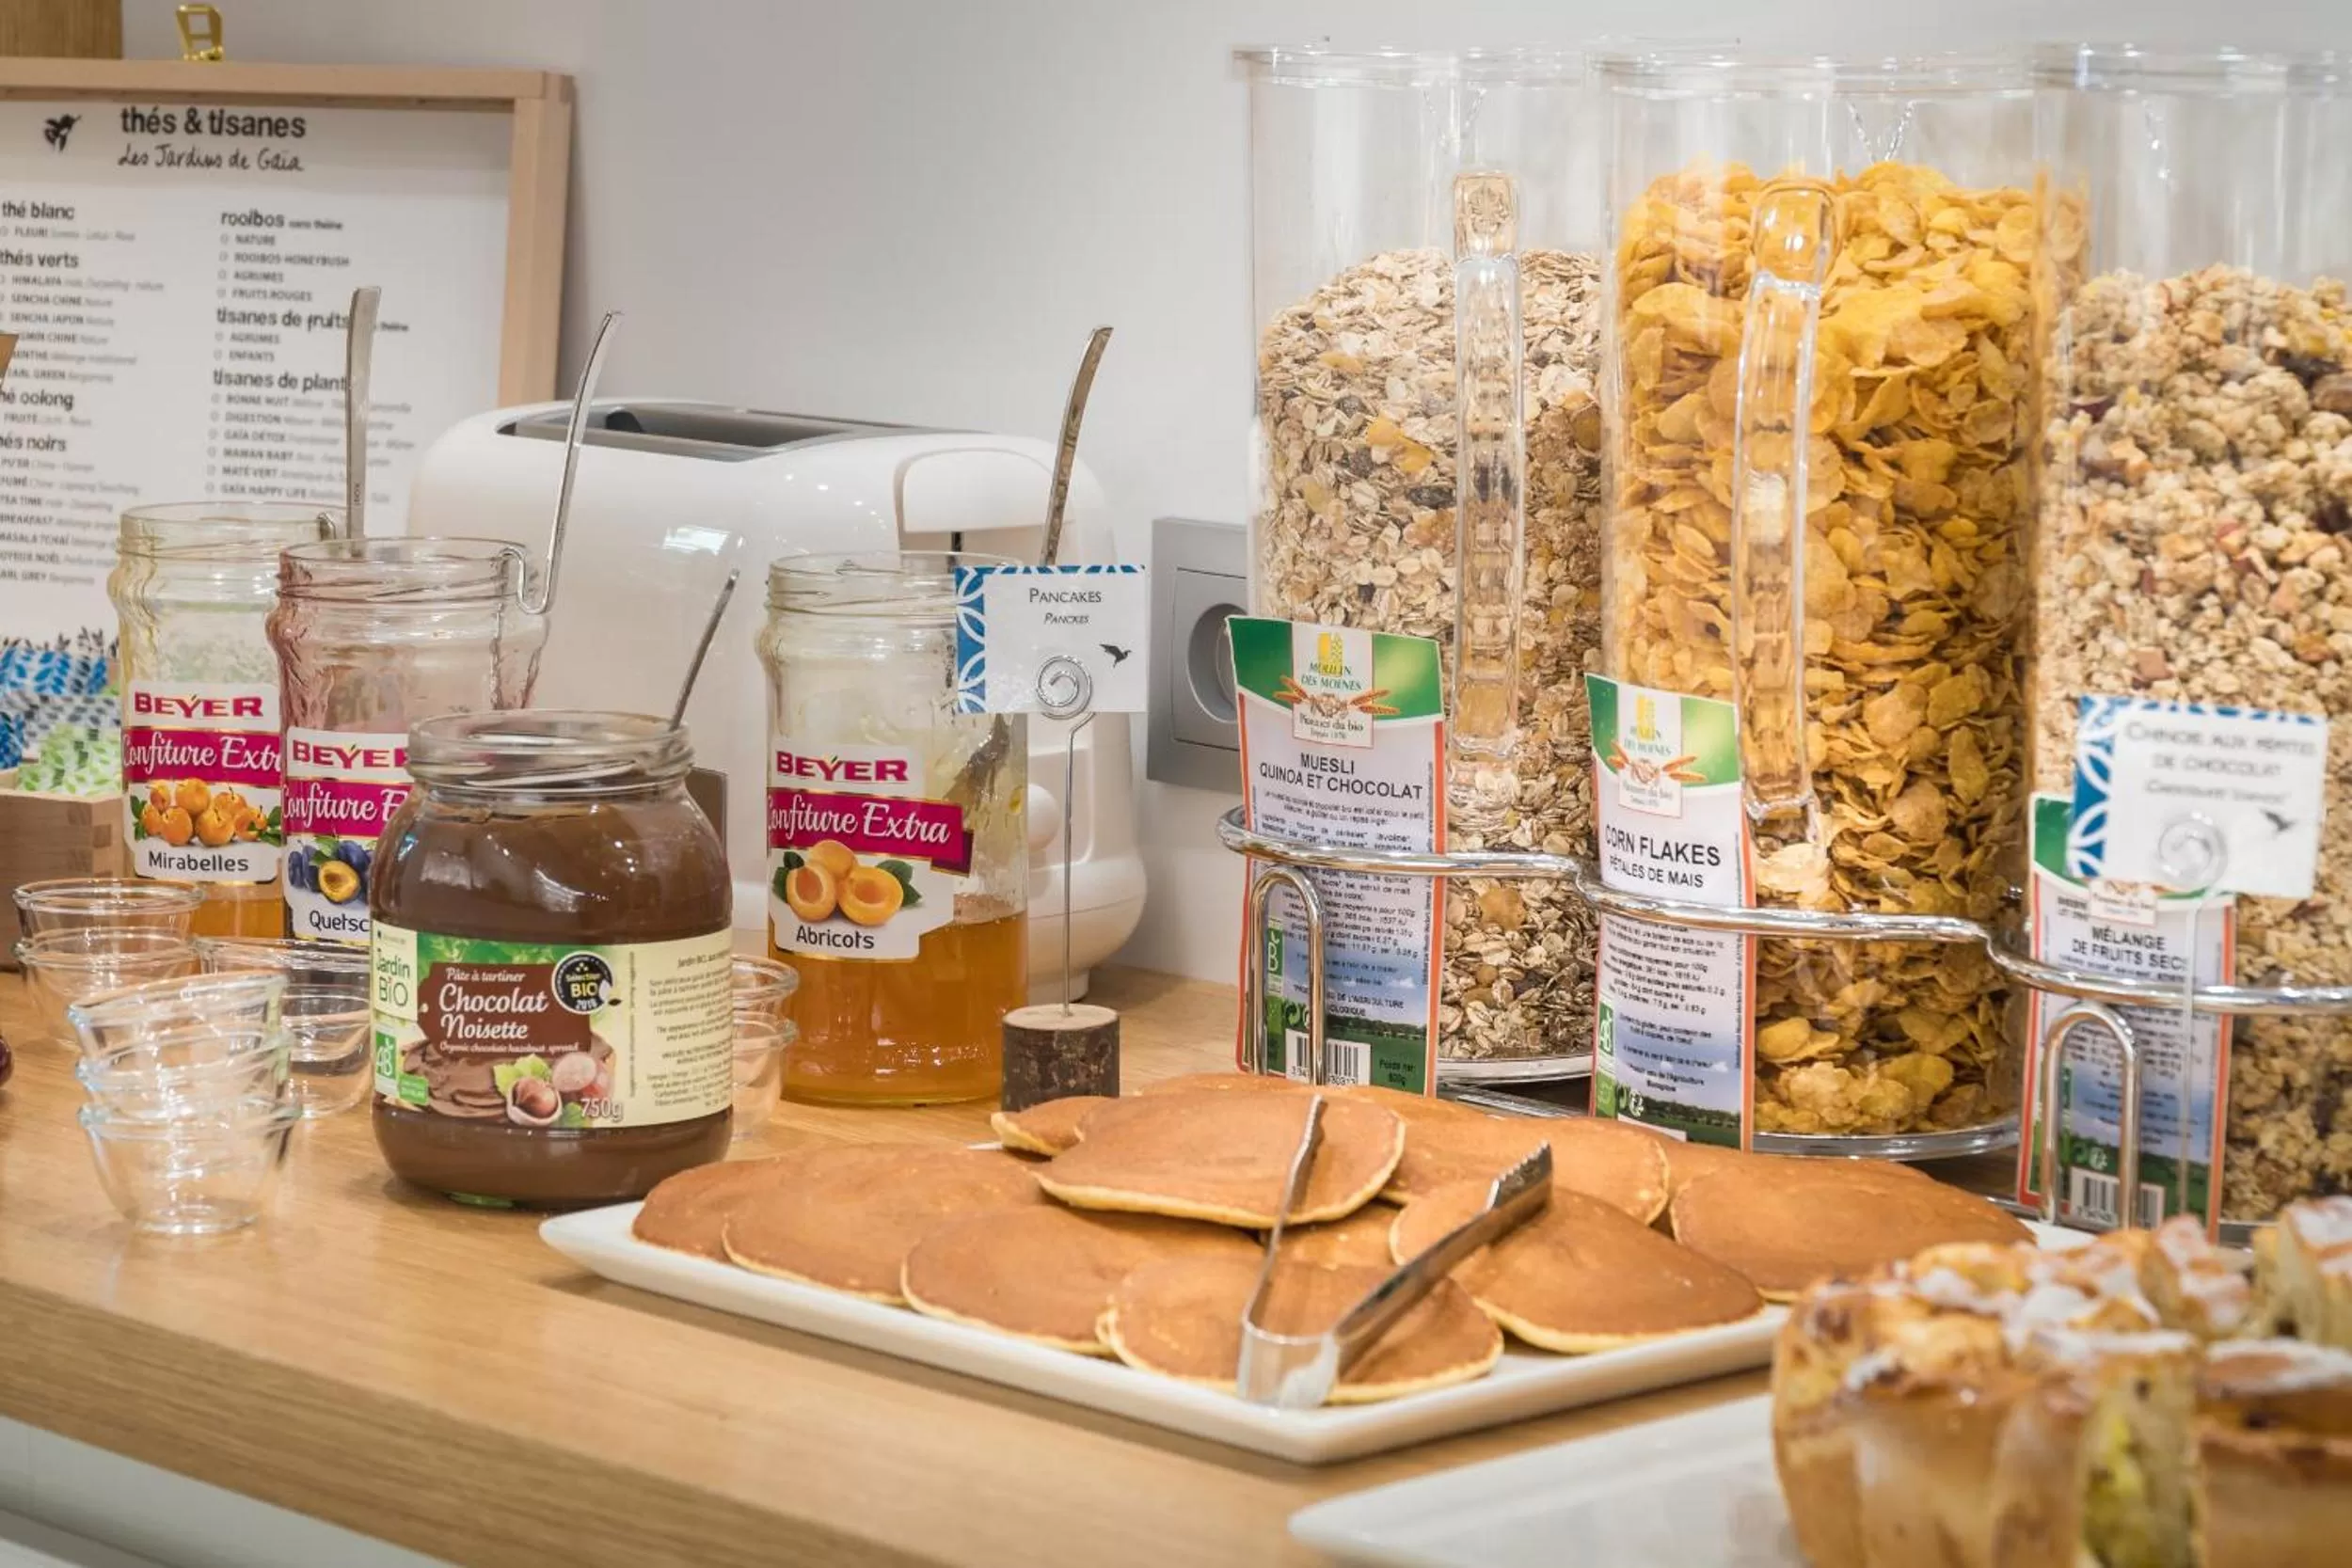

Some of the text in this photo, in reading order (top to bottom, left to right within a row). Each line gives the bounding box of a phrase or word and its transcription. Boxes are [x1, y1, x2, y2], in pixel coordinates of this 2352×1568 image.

[120, 106, 306, 137] thés & tisanes
[119, 144, 148, 166] Les
[155, 144, 222, 168] Jardins
[229, 149, 250, 169] de
[2, 200, 75, 220] thé blanc
[220, 209, 285, 227] rooibos
[0, 248, 79, 269] thés verts
[216, 306, 278, 325] tisanes
[282, 309, 302, 327] de
[213, 367, 348, 393] tisanes de plant
[0, 388, 74, 411] hé oolong
[26, 434, 66, 451] noirs
[1028, 588, 1103, 604] PANCAKES
[134, 691, 263, 719] BEYER
[122, 731, 281, 775] Confiture Extr
[1301, 752, 1355, 775] MUESLI
[776, 751, 909, 782] BEYER
[1260, 763, 1423, 800] QUINOA ET CHOCOLAT
[768, 796, 950, 846] Confiture Extra
[1606, 824, 1721, 866] CORN FLAKES
[148, 851, 249, 872] Mirabelles
[1647, 868, 1663, 883] DE
[310, 911, 370, 932] Quetsc
[796, 925, 875, 951] Abricots
[2091, 926, 2167, 952] MÉLANGE
[2072, 938, 2087, 955] DE
[2091, 943, 2142, 968] FRUITS
[445, 966, 469, 981] Pâte
[481, 970, 526, 984] tartiner
[438, 983, 549, 1014] Chocolat
[570, 982, 598, 999] BIO
[440, 1013, 529, 1041] Noisette
[580, 1096, 624, 1123] 750g
